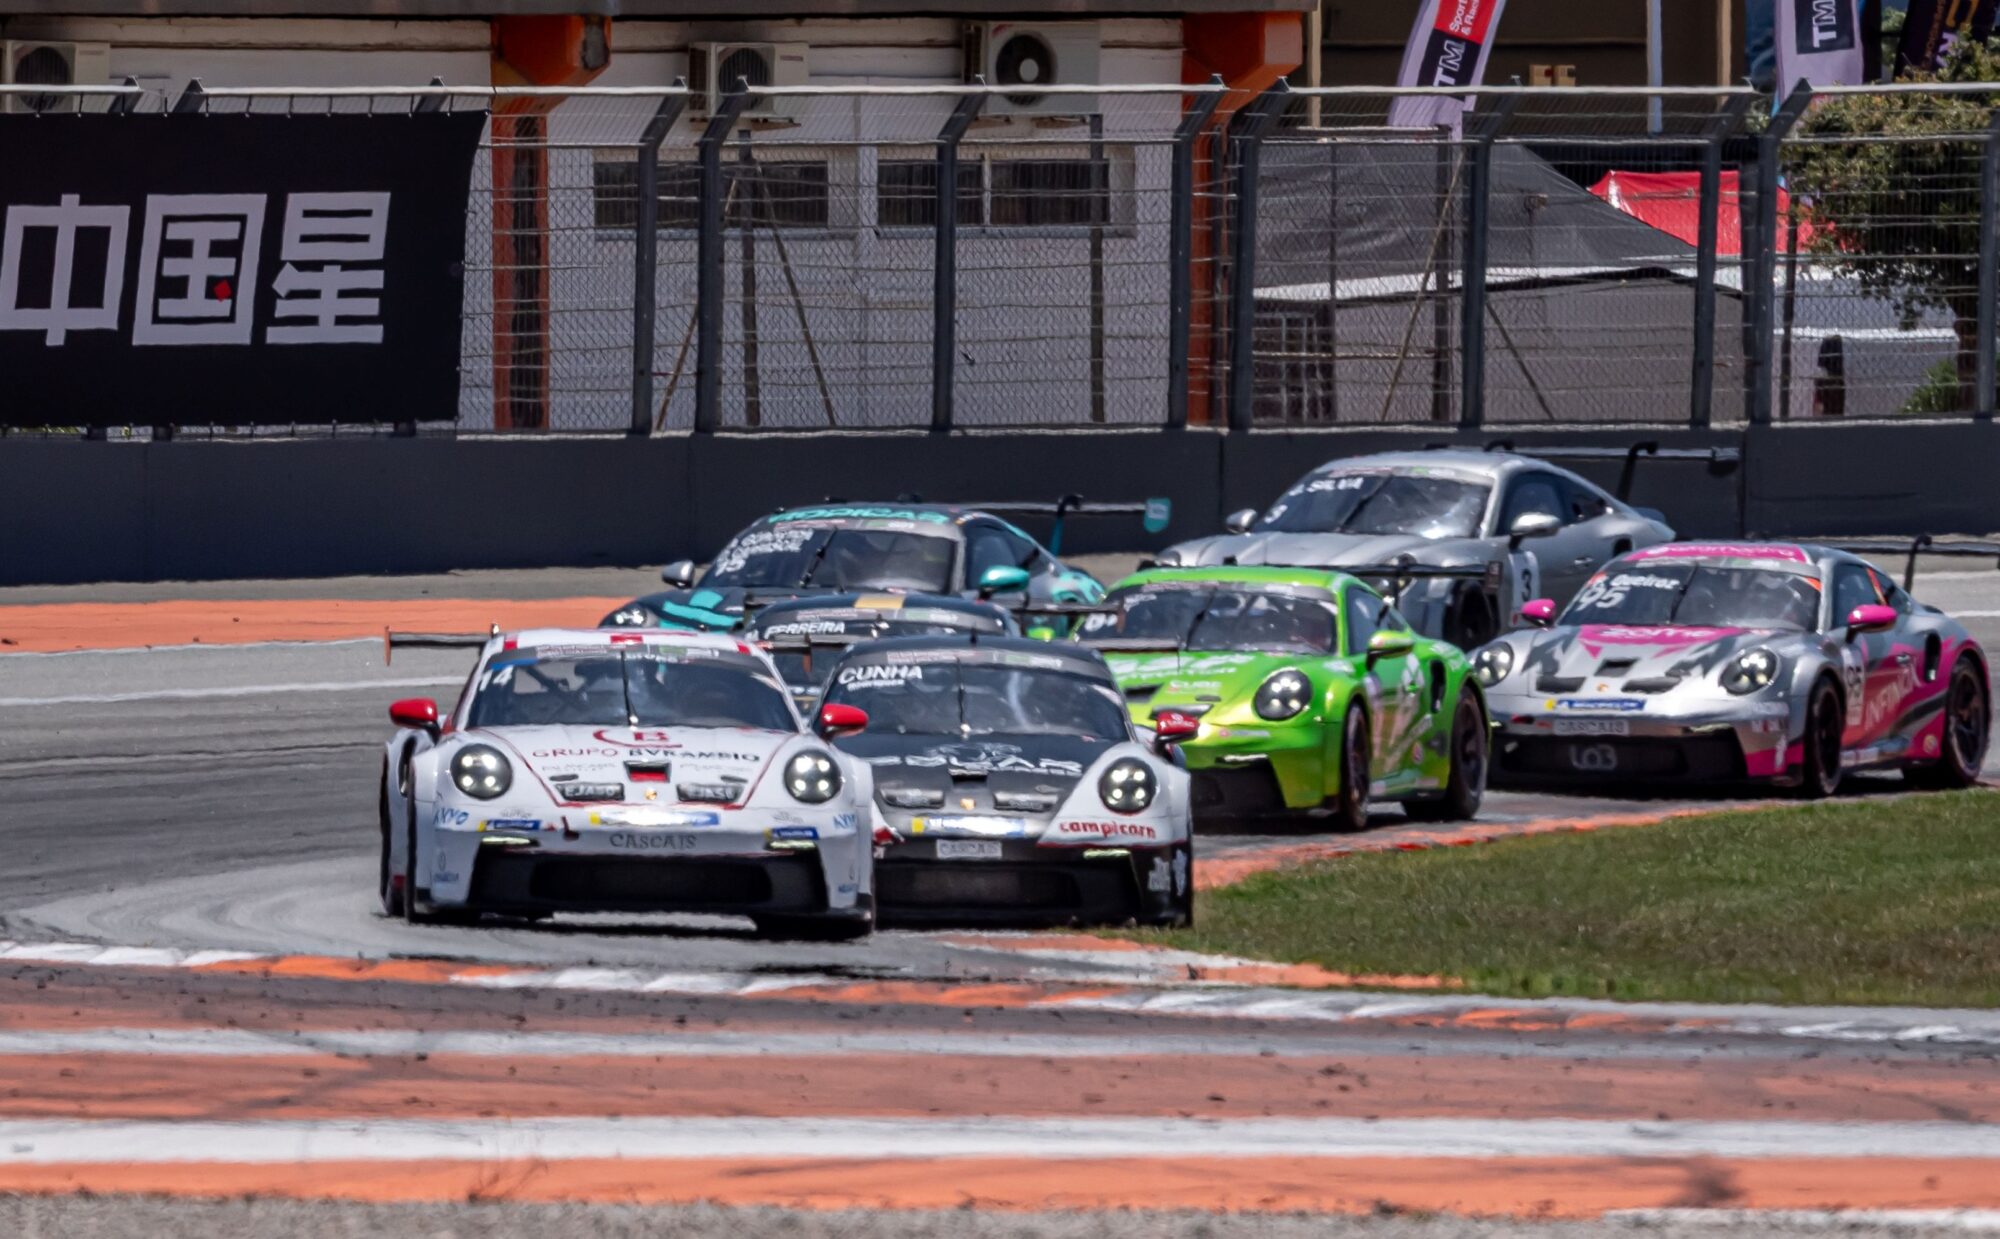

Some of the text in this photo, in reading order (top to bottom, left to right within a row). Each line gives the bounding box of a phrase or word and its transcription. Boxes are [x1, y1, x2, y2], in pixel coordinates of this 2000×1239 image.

[1812, 0, 1837, 48] TM
[1432, 40, 1466, 88] TM
[0, 191, 392, 347] 中国星
[1521, 568, 1532, 602] 3
[1575, 585, 1632, 612] 95
[764, 621, 845, 640] FERREIRA
[479, 664, 515, 691] 14
[838, 665, 923, 685] CUNHA
[532, 747, 618, 758] GRUPO
[609, 833, 698, 849] CASCAIS
